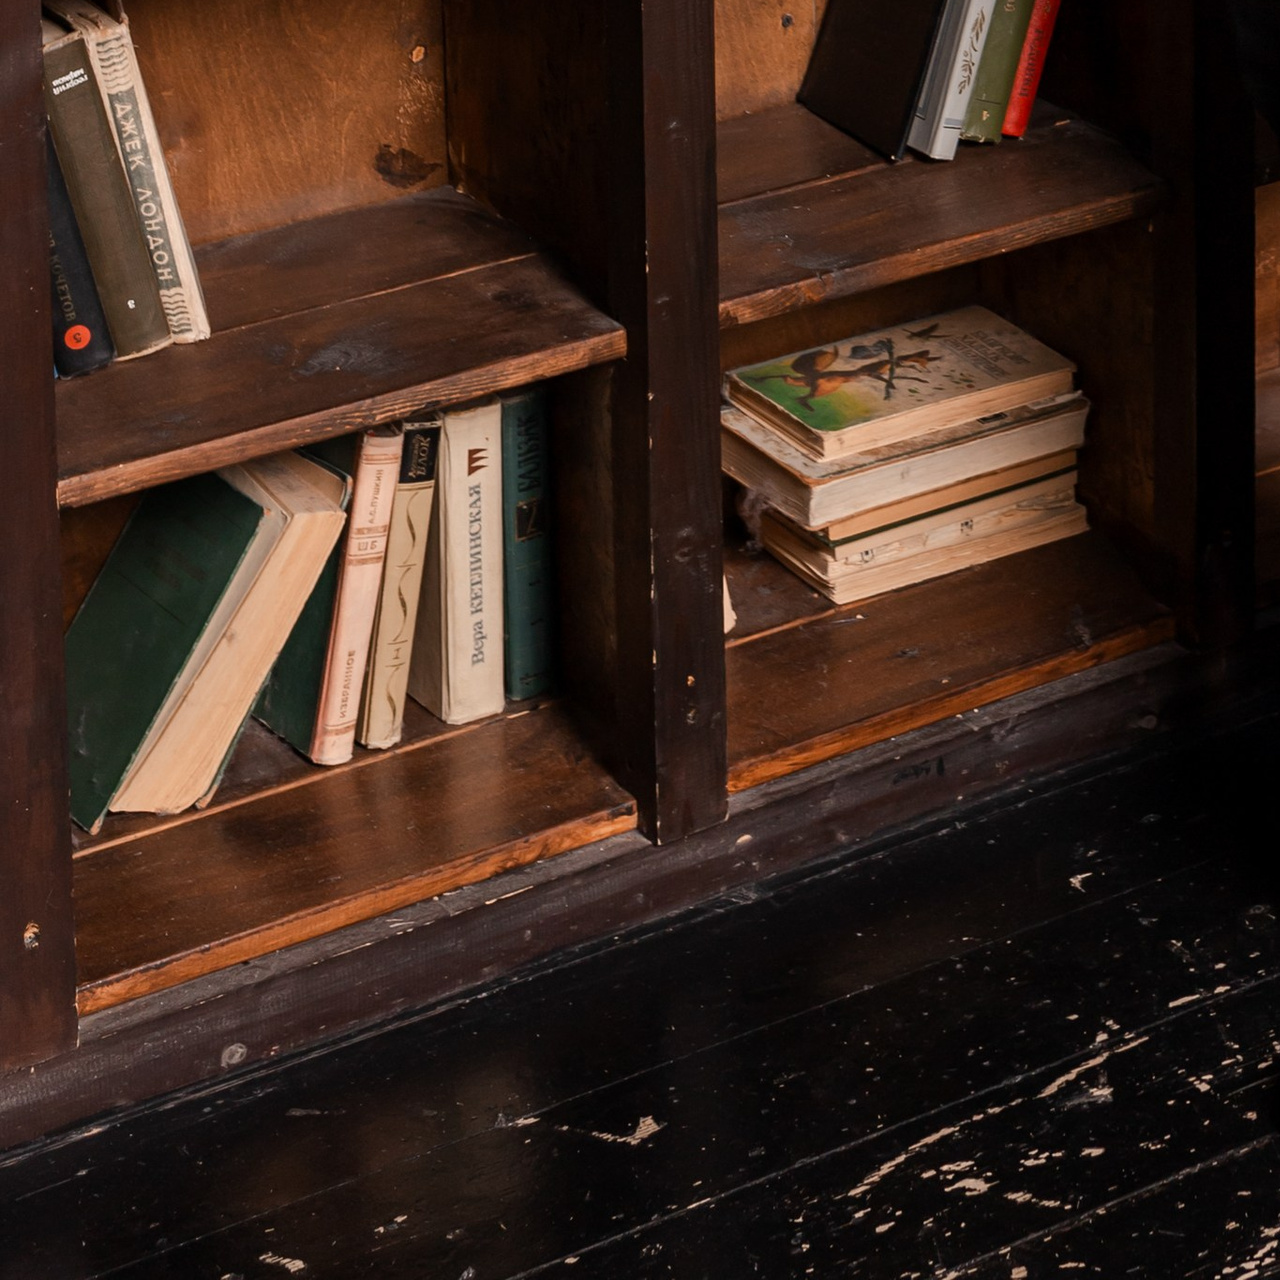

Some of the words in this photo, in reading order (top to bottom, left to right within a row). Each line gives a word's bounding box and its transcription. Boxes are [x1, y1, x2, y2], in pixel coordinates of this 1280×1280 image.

[52, 68, 84, 87] марков
[53, 74, 88, 96] георгий
[113, 101, 146, 171] ДЖЕК
[136, 185, 174, 284] ЛОНДОН
[415, 433, 431, 482] БЛОК
[468, 482, 485, 616] КЕТЛИНСКАЯ
[472, 619, 487, 667] Вера
[338, 650, 356, 720] ИЗБРАННОЕ
